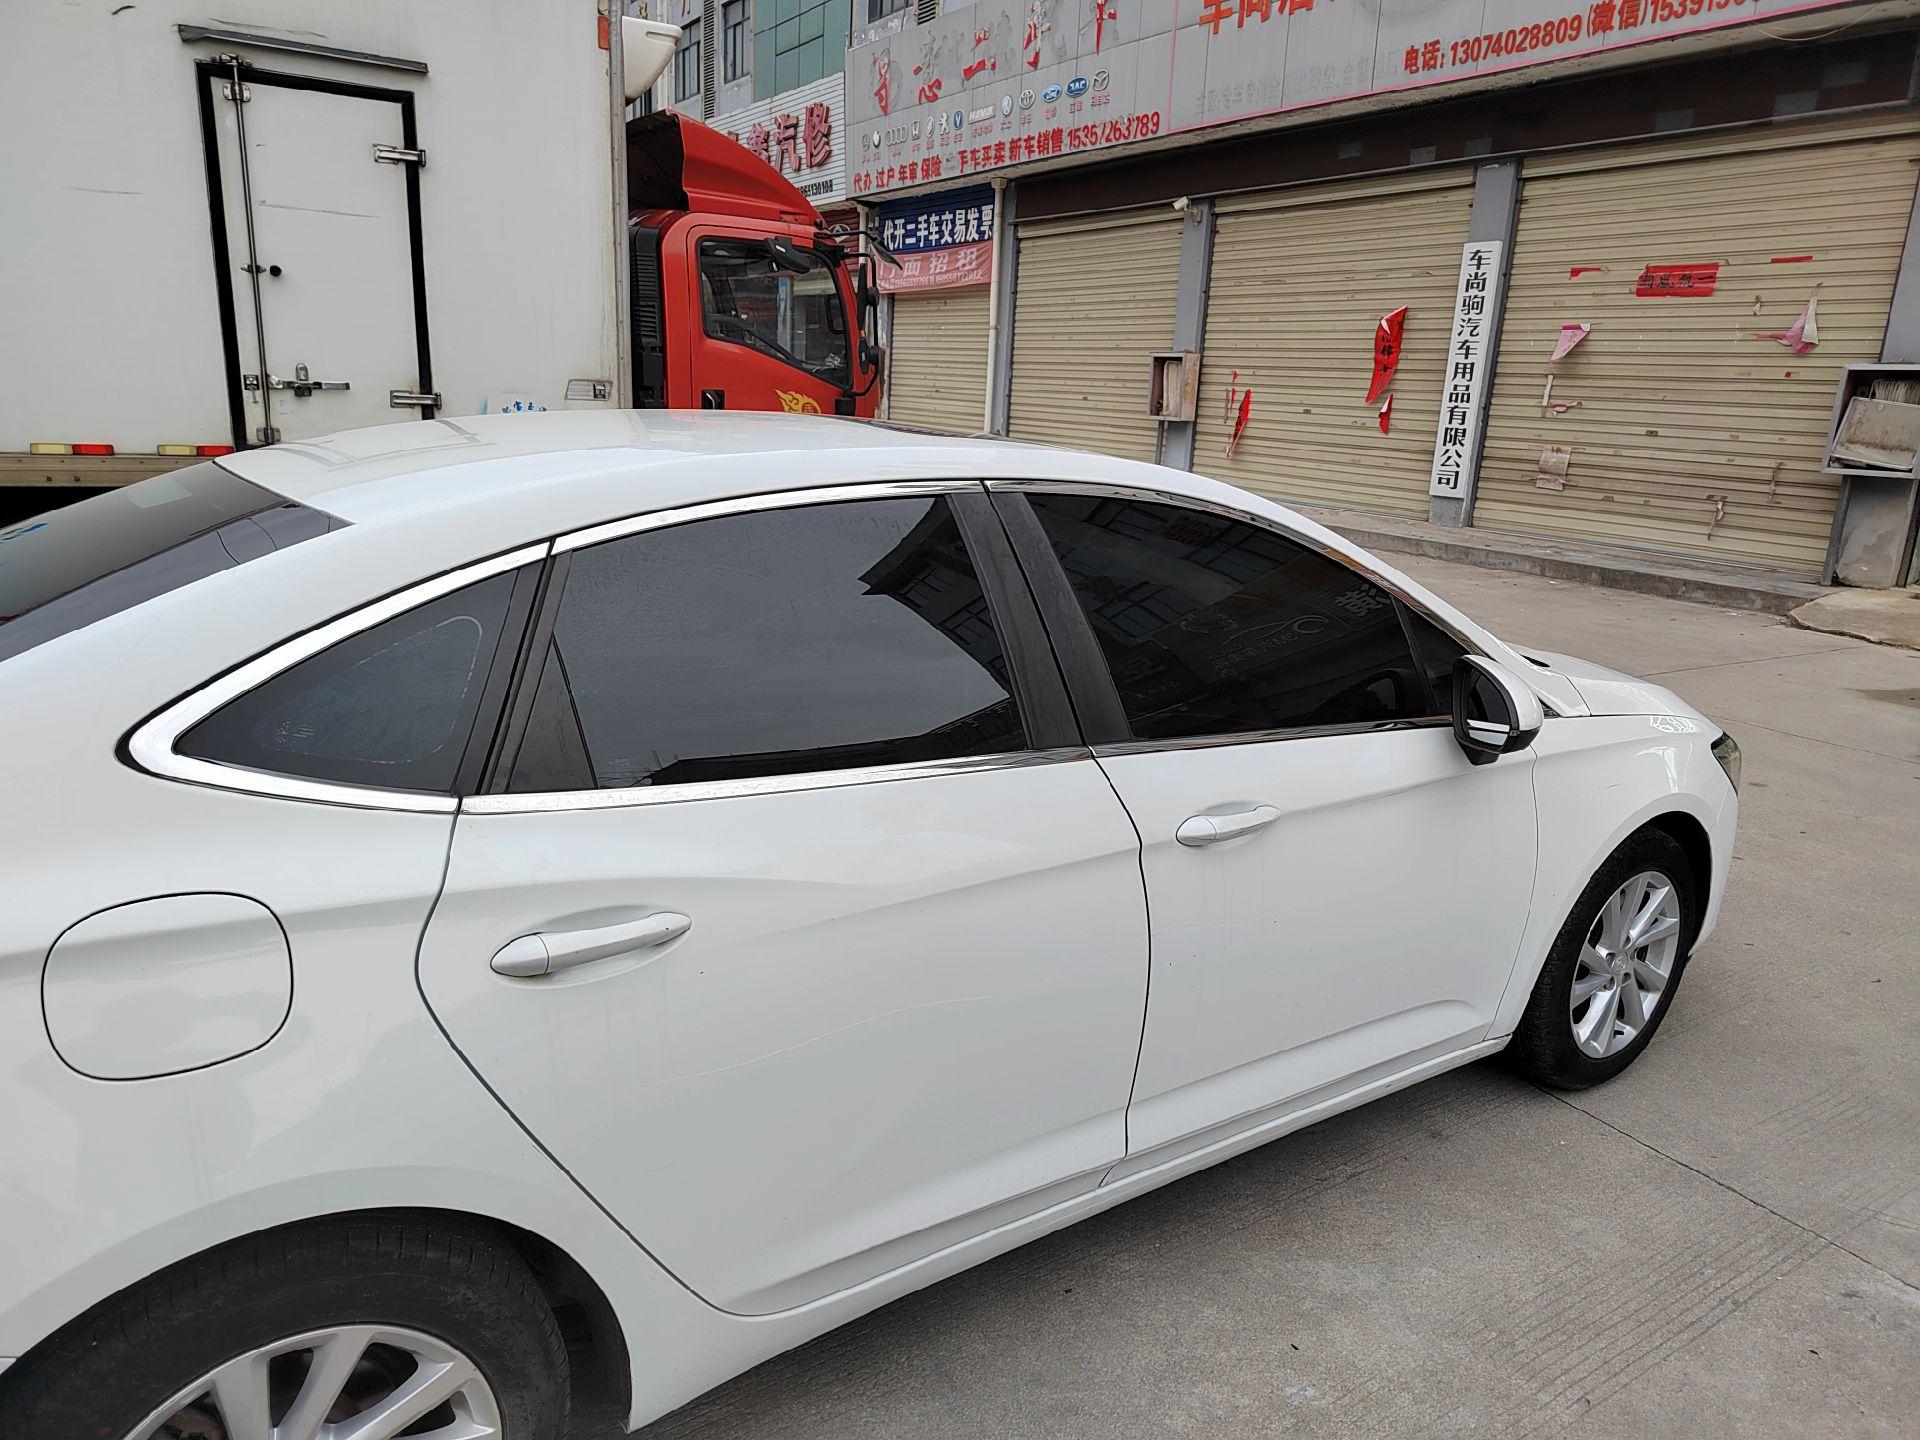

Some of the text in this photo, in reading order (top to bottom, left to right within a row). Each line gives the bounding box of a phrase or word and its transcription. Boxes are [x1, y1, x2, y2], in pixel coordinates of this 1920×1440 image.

[883, 204, 994, 251] 代开二手车交易发票
[1436, 249, 1493, 490] 车尚驹汽车用品有限公司
